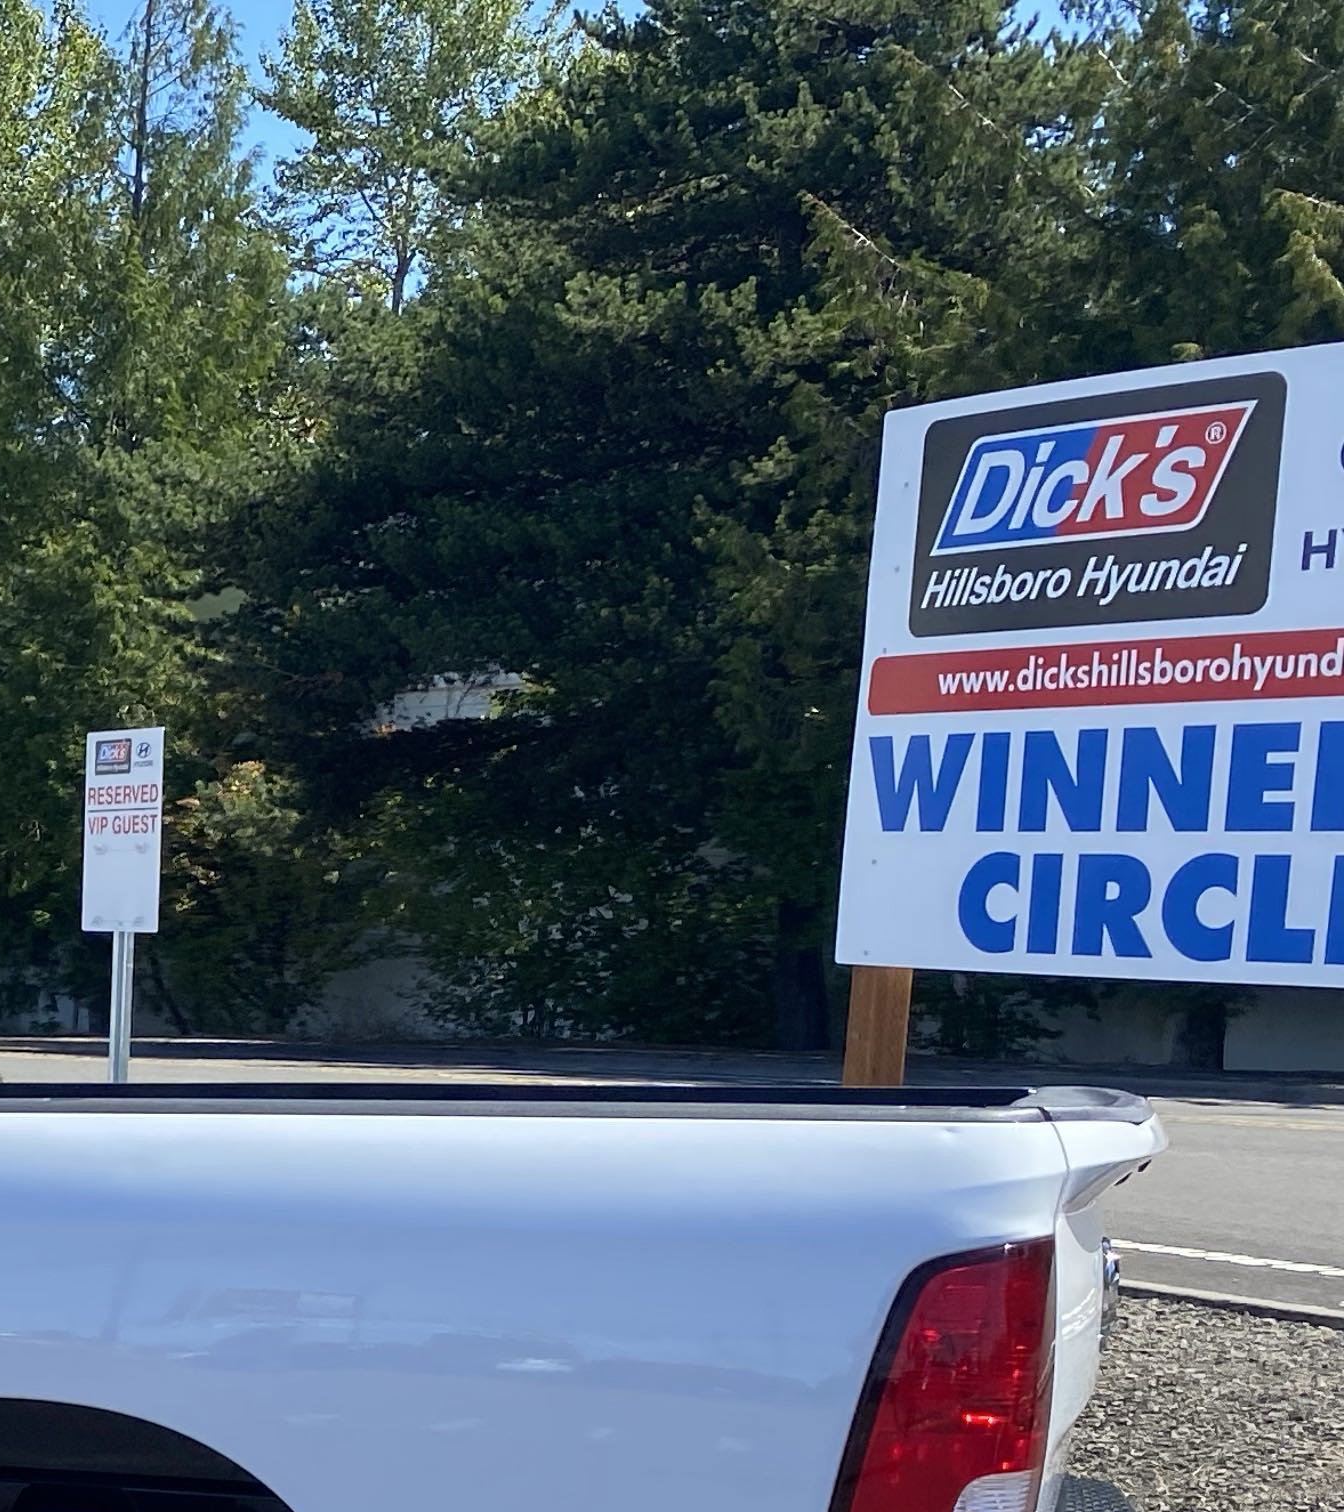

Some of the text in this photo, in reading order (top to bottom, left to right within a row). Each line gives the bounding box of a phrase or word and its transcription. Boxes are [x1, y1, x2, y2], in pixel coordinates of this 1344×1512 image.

[952, 424, 1207, 538] Dick's
[920, 542, 1248, 609] Hillsboro Hyundai
[88, 783, 159, 806] RESERVED
[88, 814, 158, 835] VIP GUEST
